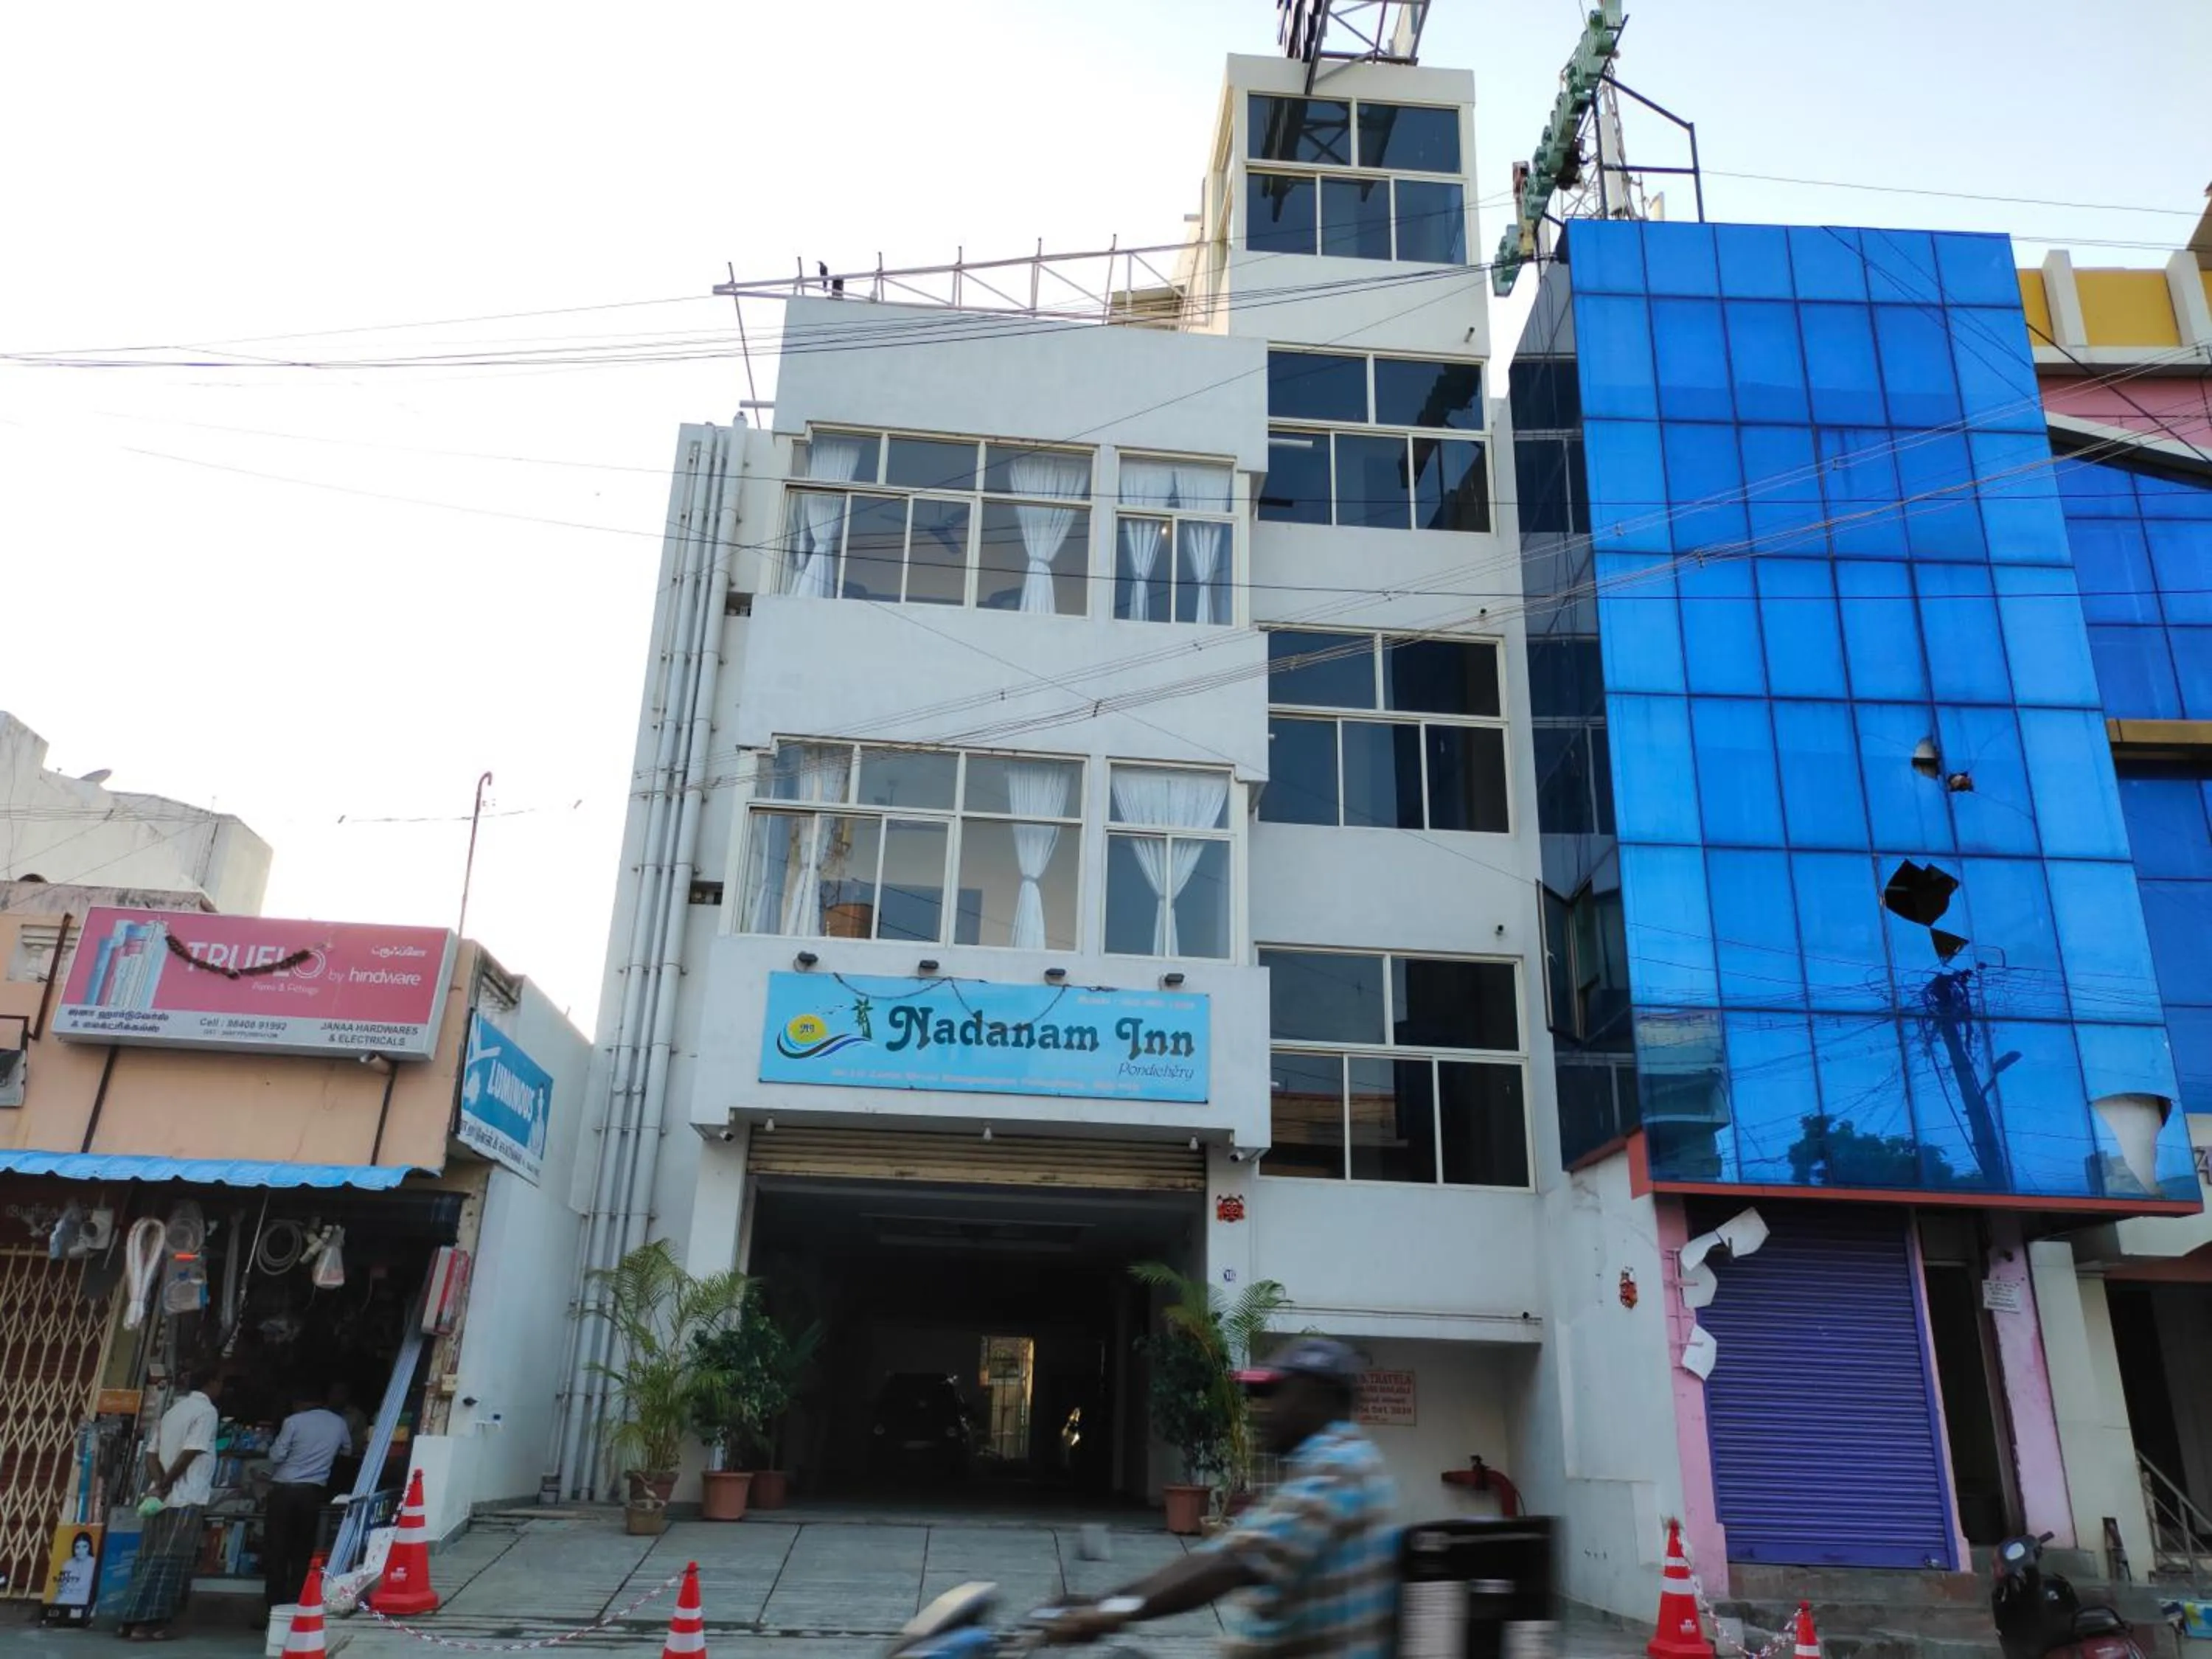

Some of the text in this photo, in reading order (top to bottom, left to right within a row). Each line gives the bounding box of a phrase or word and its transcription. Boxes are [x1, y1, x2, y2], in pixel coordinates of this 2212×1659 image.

[329, 967, 344, 984] by
[348, 967, 421, 987] hindware
[200, 1017, 219, 1027] Cell
[321, 1022, 419, 1036] JANAA HARDWARES
[328, 1034, 406, 1046] & ELECTRICALS
[886, 1005, 1195, 1061] Nadanam Inn
[487, 1059, 535, 1122] LUMINOUS
